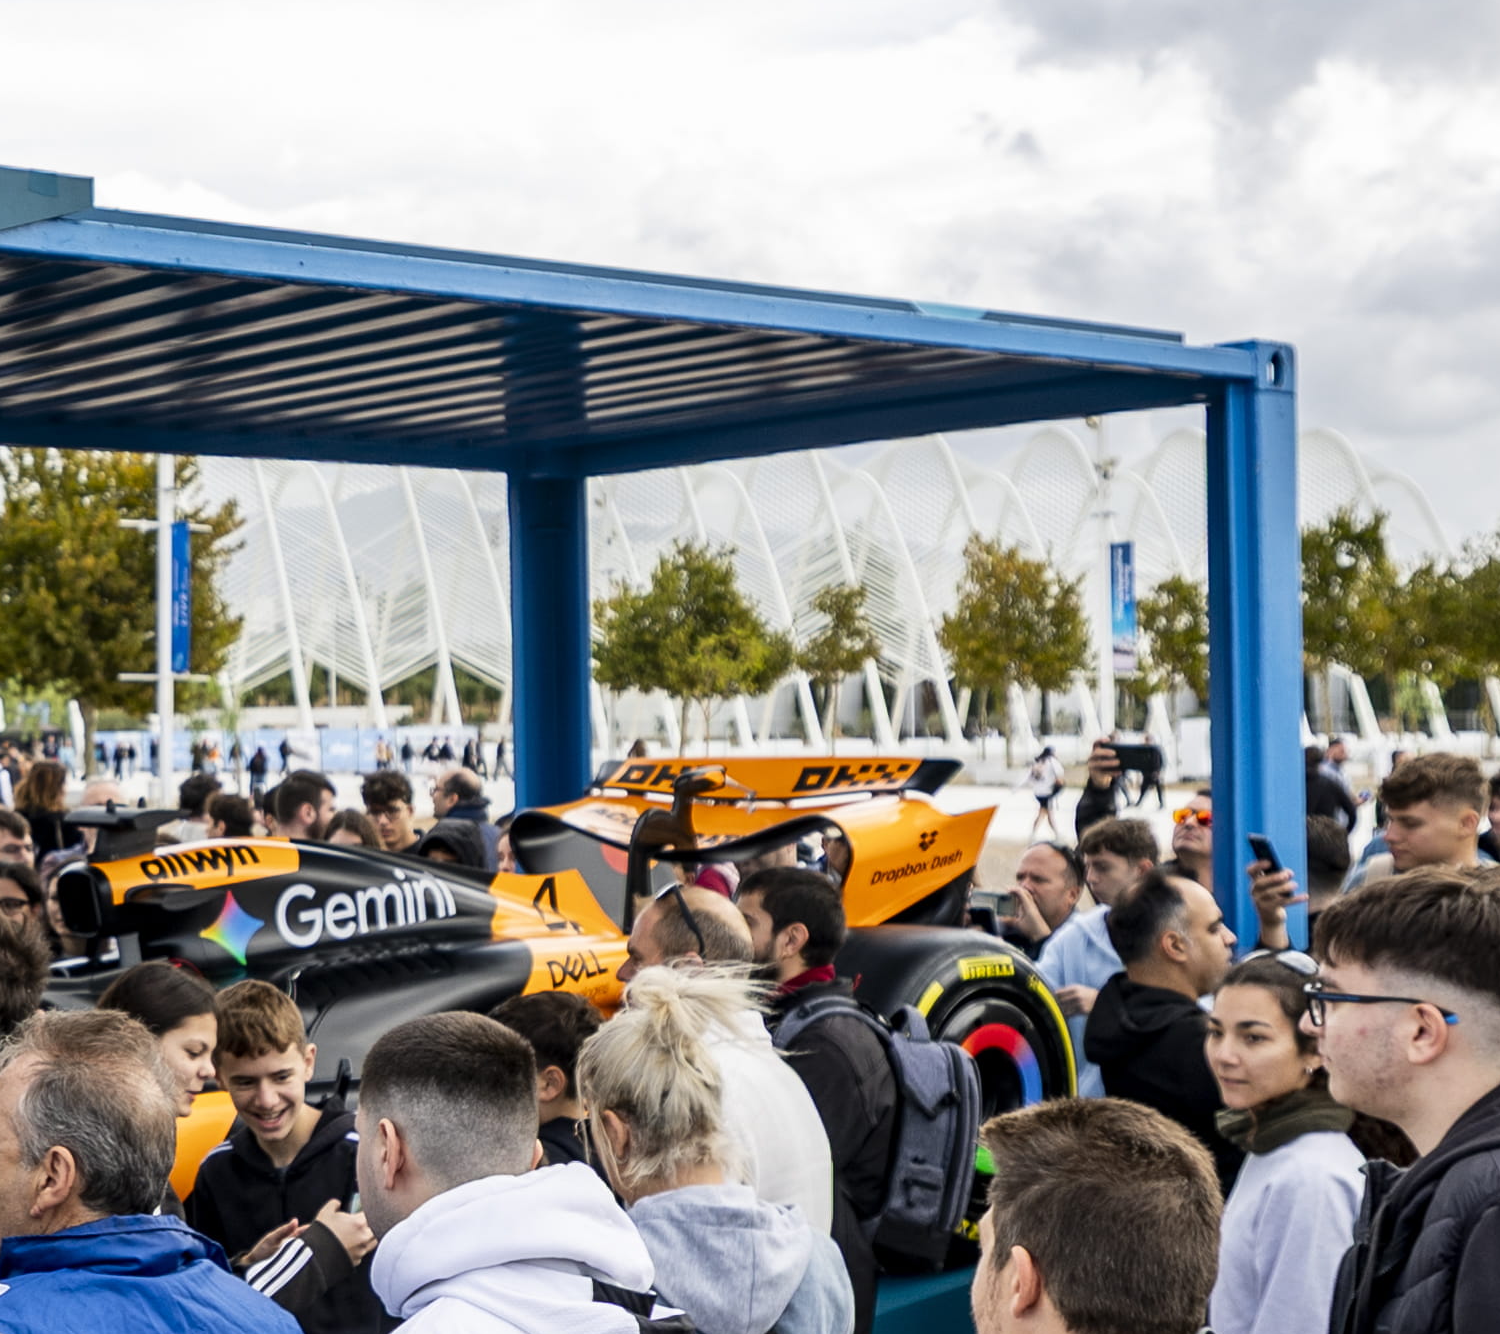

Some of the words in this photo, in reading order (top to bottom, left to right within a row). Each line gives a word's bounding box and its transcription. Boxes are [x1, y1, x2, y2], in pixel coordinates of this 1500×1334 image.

[870, 862, 928, 886] Dropbox
[930, 849, 963, 871] Dash
[275, 868, 457, 948] Gemini
[546, 950, 609, 989] DELL
